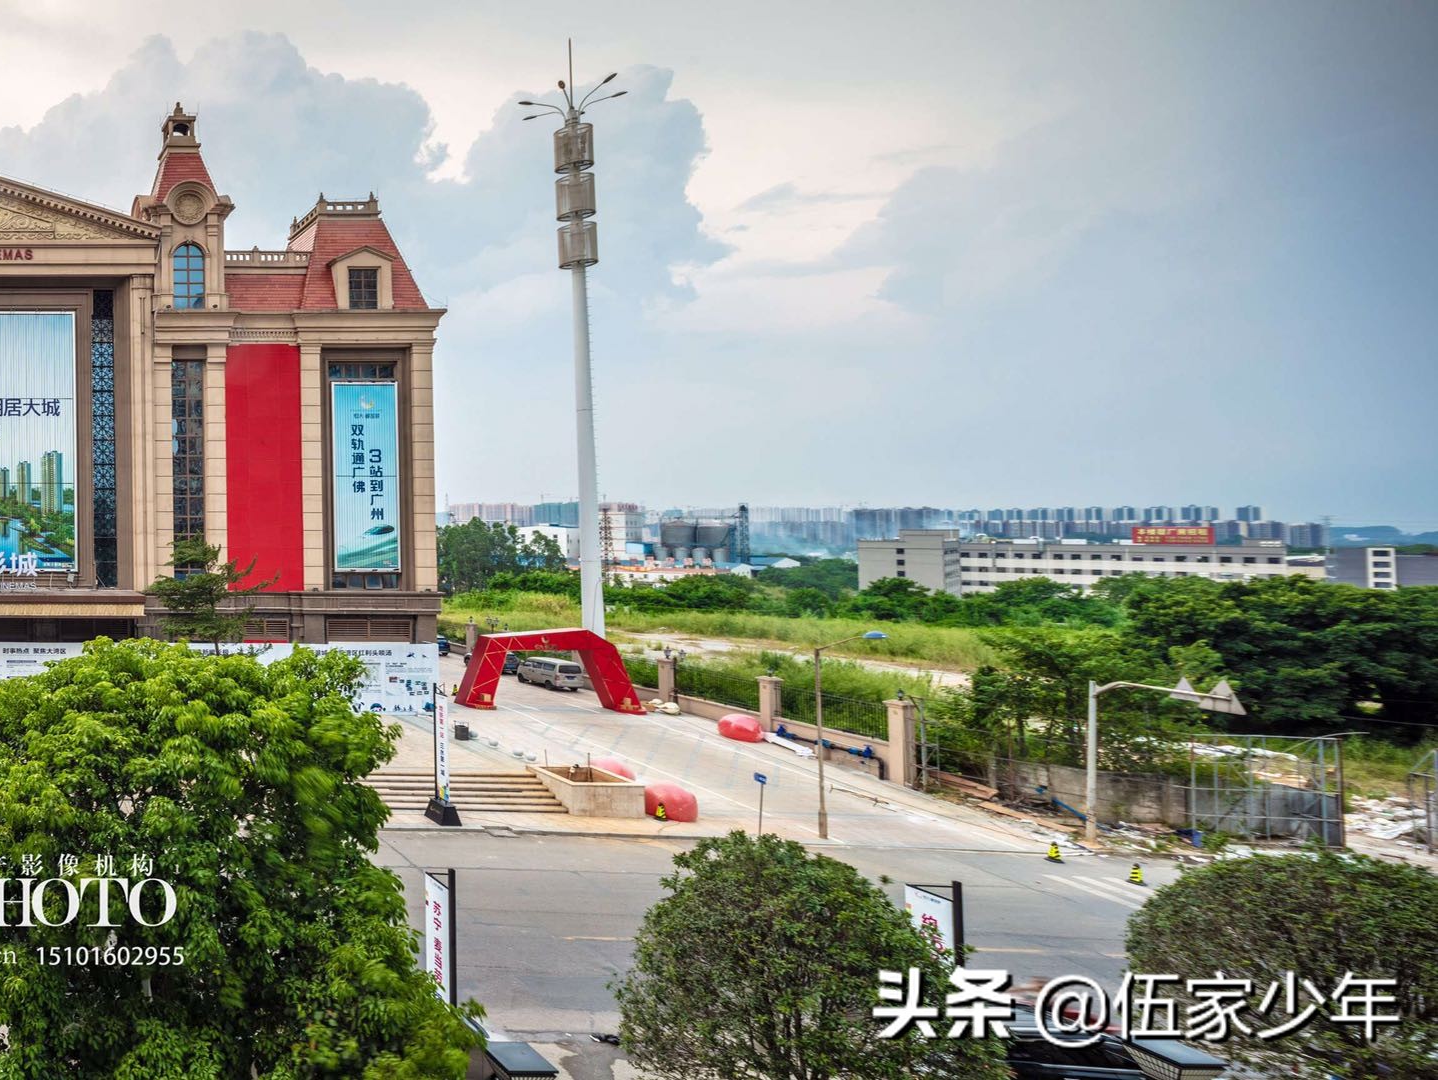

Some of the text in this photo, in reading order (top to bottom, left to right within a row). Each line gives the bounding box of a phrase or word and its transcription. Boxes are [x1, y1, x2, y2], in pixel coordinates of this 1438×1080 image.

[351, 424, 365, 493] 双轨通广佛
[369, 448, 384, 520] 3站到广州
